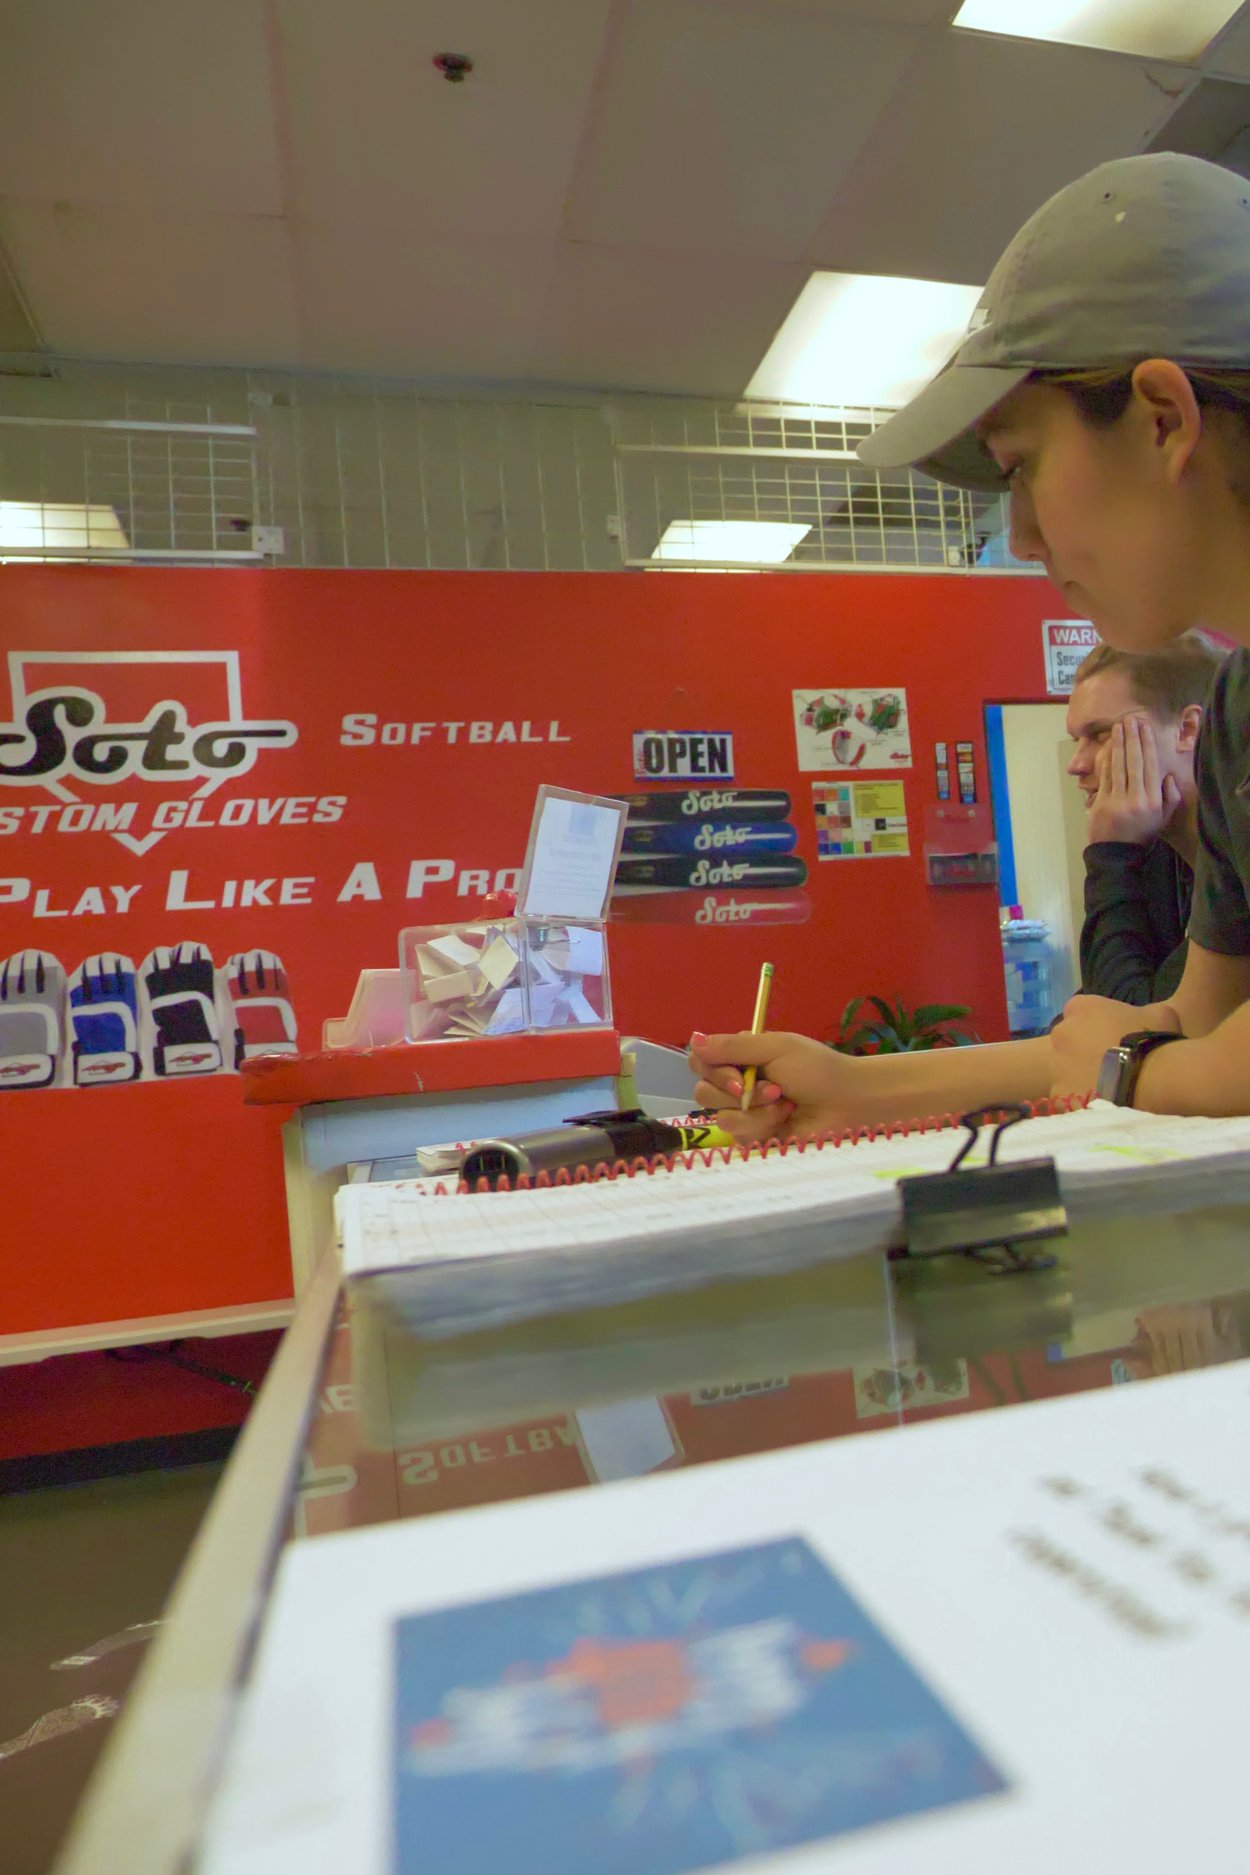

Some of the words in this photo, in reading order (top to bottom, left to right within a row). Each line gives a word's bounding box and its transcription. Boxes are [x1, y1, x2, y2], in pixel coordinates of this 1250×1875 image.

[0, 686, 298, 786] Soto
[340, 713, 571, 746] SOFTBALL
[643, 737, 729, 775] OPEN
[152, 796, 348, 830] GLOVES
[165, 869, 315, 911] LIKE
[337, 862, 382, 902] A
